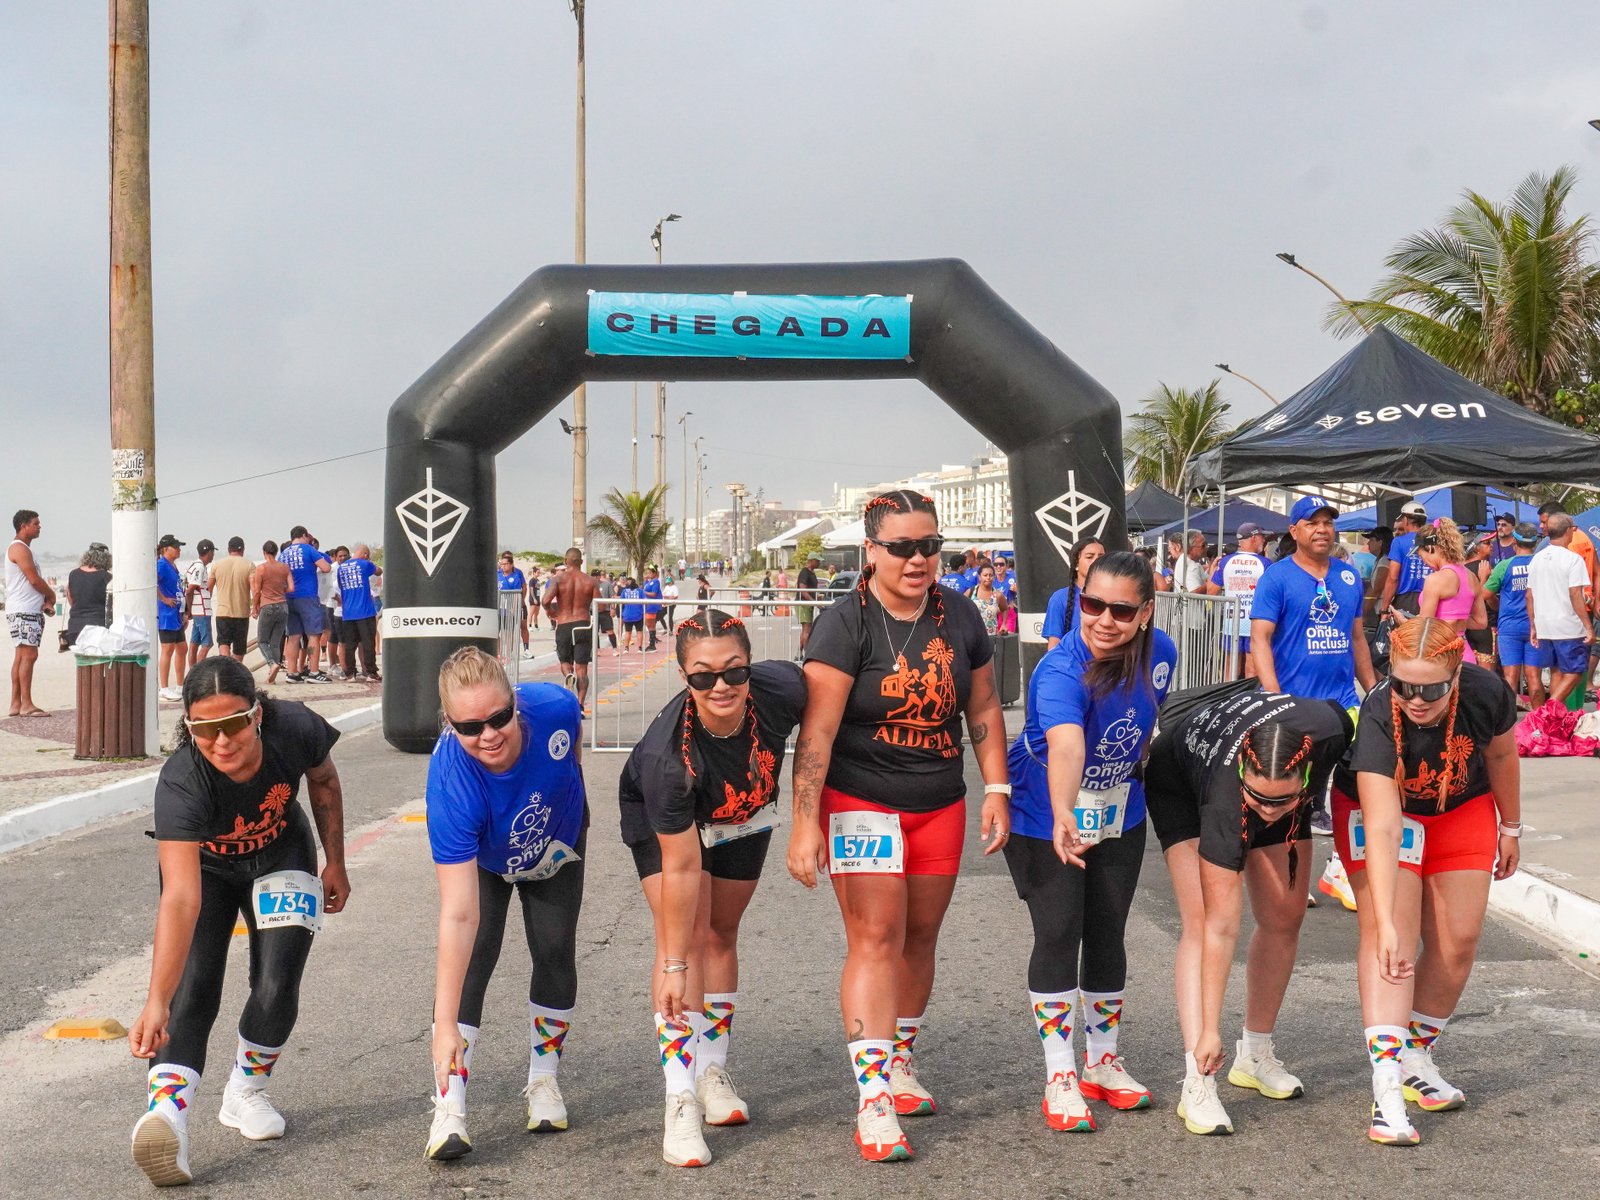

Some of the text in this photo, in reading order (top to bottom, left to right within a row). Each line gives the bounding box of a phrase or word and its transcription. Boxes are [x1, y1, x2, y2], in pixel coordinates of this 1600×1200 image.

[606, 313, 892, 339] CHEGADA
[1355, 402, 1487, 426] seven
[402, 615, 482, 627] seven.eco7
[1306, 625, 1339, 638] Onda
[872, 725, 953, 750] ALDEIA
[1085, 761, 1131, 777] Onda
[507, 836, 551, 867] Onda
[844, 836, 882, 857] 577
[270, 892, 309, 914] 734
